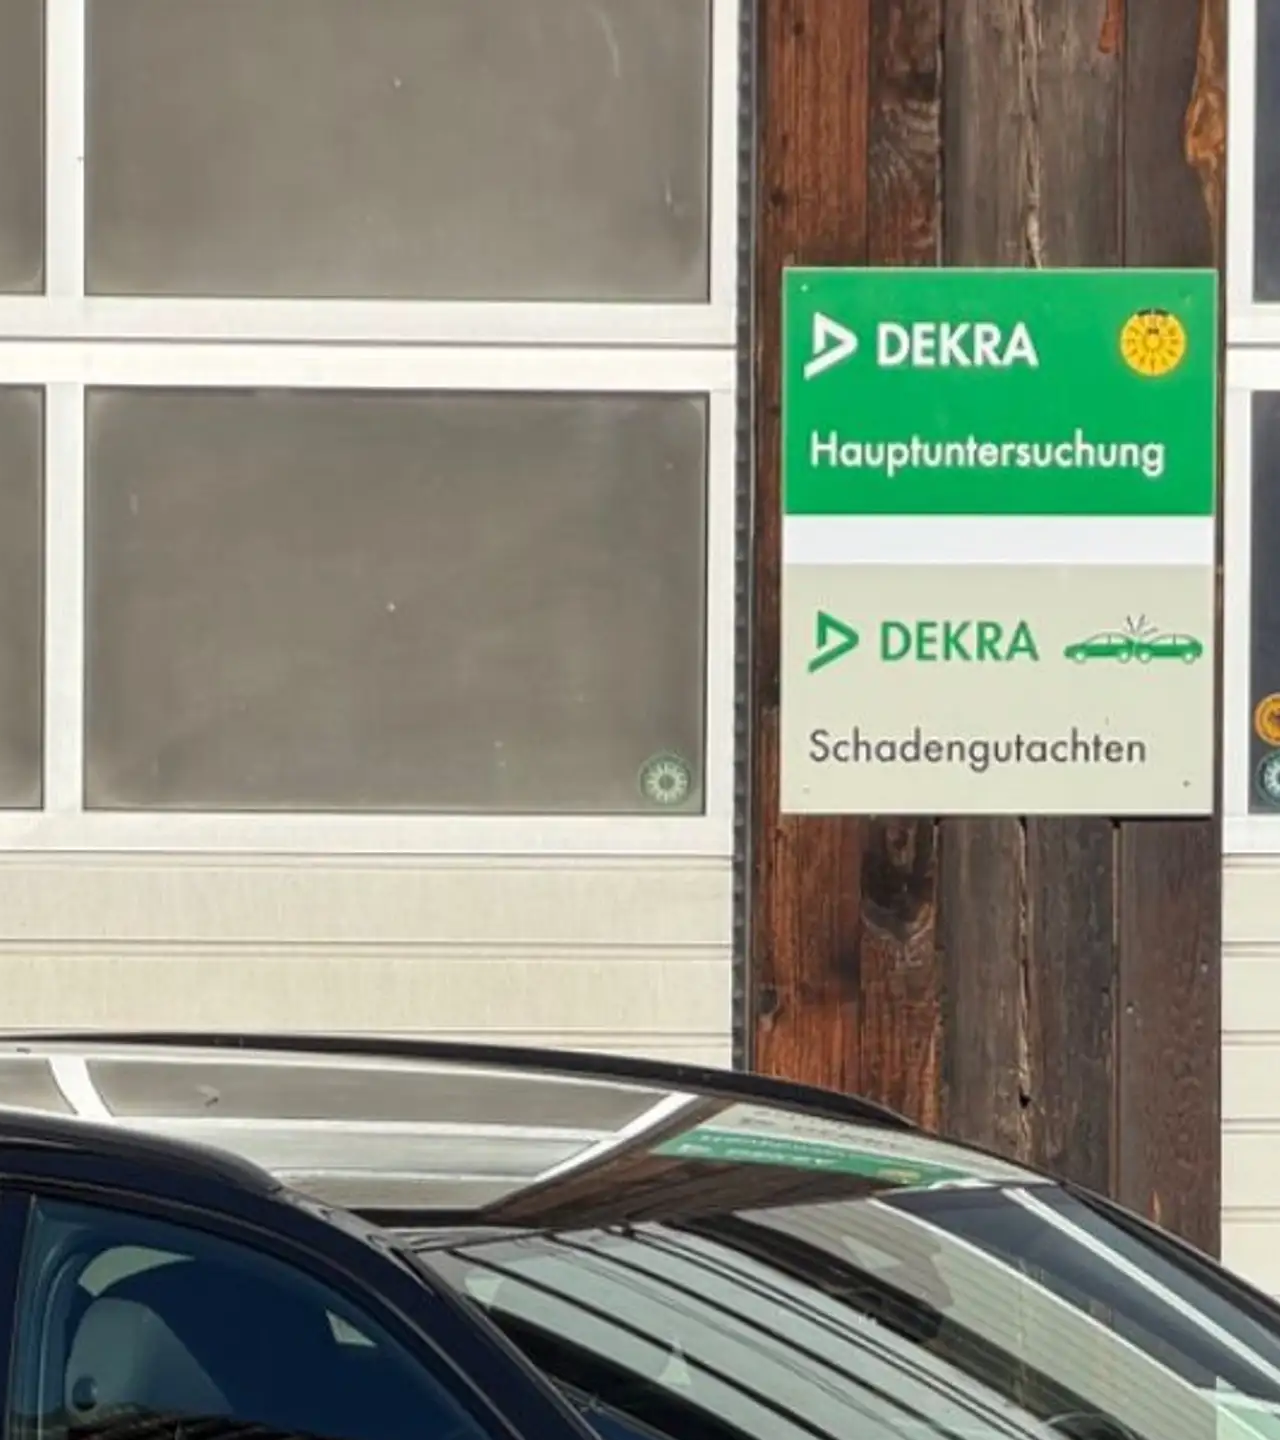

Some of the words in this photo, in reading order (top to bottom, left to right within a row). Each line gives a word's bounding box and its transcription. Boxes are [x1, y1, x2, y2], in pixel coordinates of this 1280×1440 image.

[876, 320, 1039, 368] DEKRA
[809, 429, 1166, 478] Hauptuntersuchung
[879, 620, 1040, 663] DEKRA
[808, 727, 1147, 773] Schadengutachten
